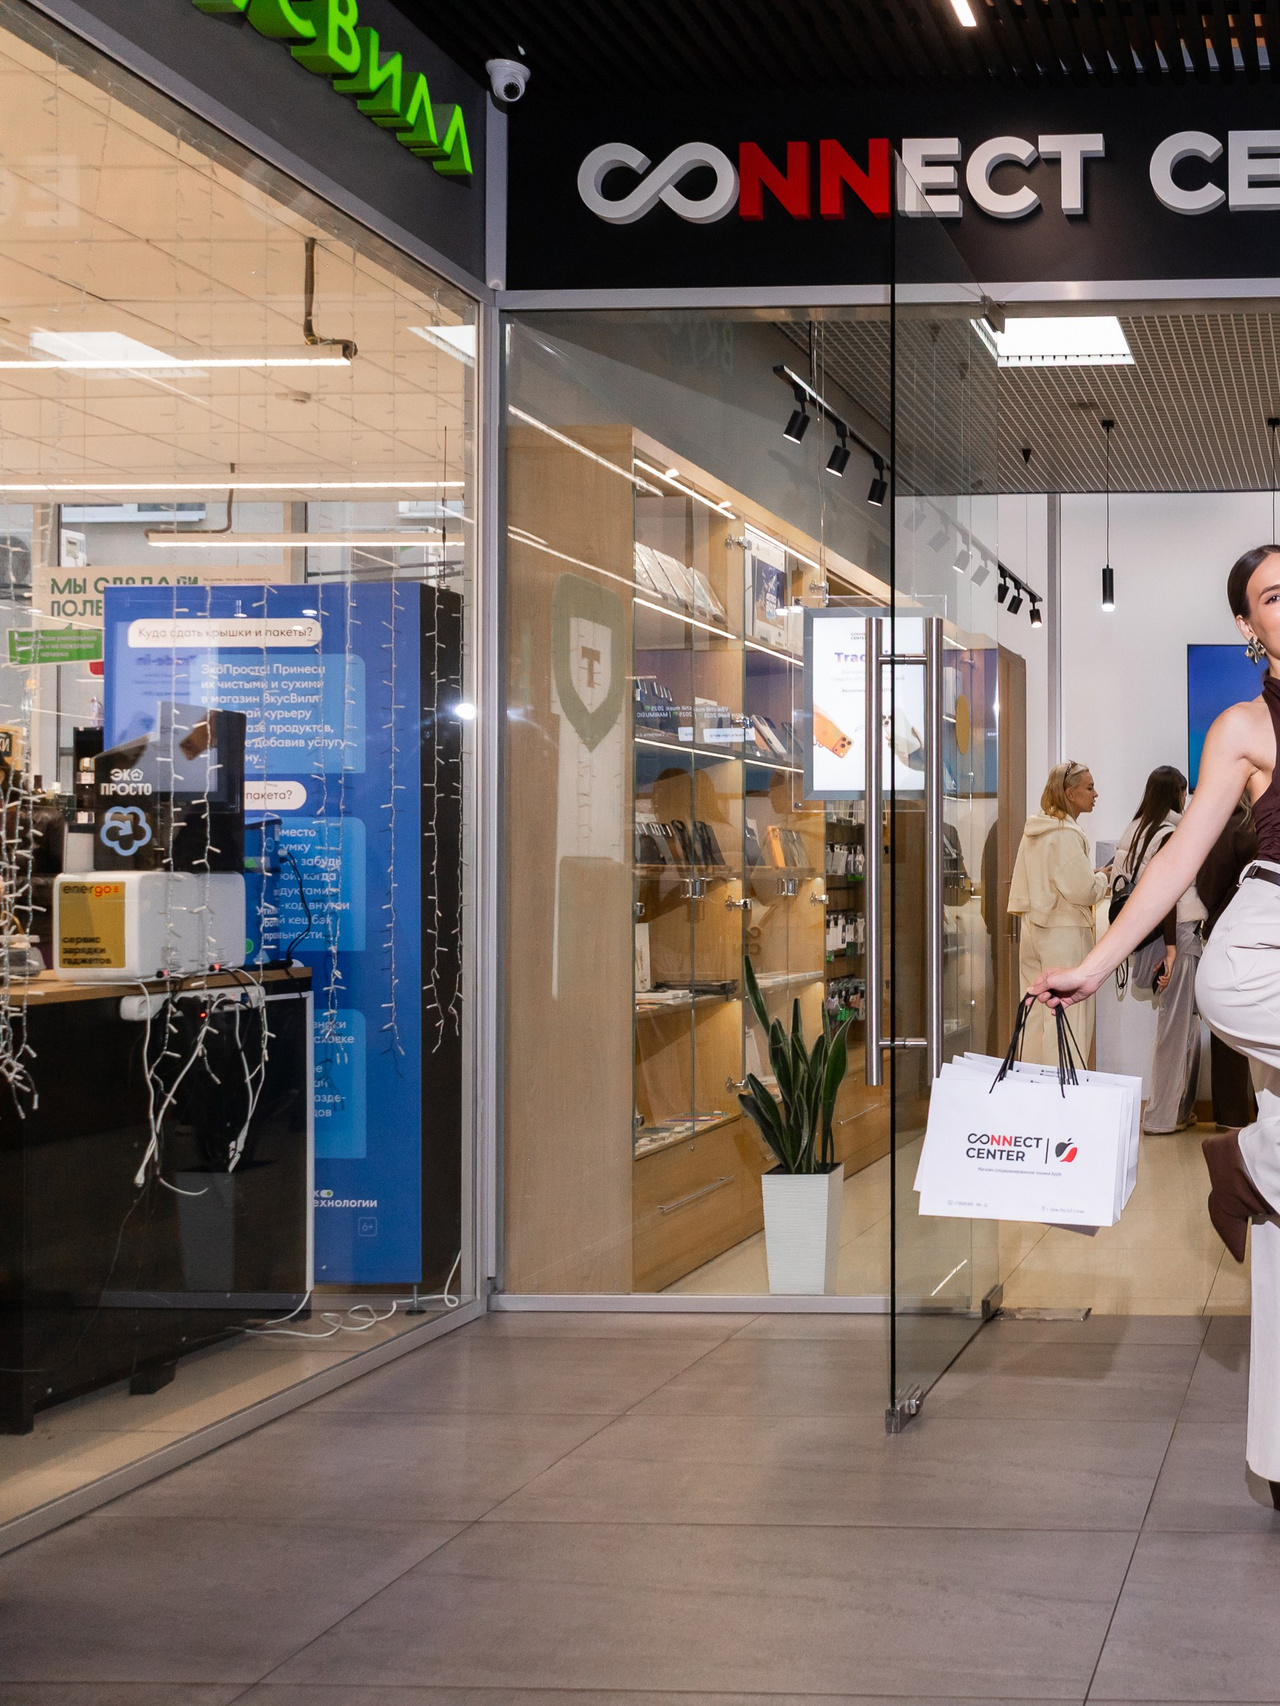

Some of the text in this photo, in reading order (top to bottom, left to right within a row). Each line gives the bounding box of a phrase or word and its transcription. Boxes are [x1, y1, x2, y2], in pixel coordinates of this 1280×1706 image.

[577, 133, 1105, 225] CONNECT
[50, 577, 87, 595] МЫ
[138, 626, 313, 640] Куда сдать крышки и пакеты?
[273, 663, 326, 676] Принеси
[217, 680, 268, 690] чистыми
[270, 680, 279, 690] и
[281, 679, 325, 691] сухими
[211, 693, 260, 704] магазин
[263, 692, 320, 705] ВкусВилл
[269, 723, 334, 735] продуктов,
[254, 737, 305, 750] добавив
[307, 737, 345, 750] услугу
[100, 782, 153, 796] ПРОСТО
[245, 789, 293, 801] пакета?
[62, 885, 112, 898] energo
[62, 936, 101, 946] сервис
[967, 1132, 1043, 1149] CONNECT
[965, 1147, 1026, 1162] CENTER
[314, 1199, 378, 1208] ехнологии
